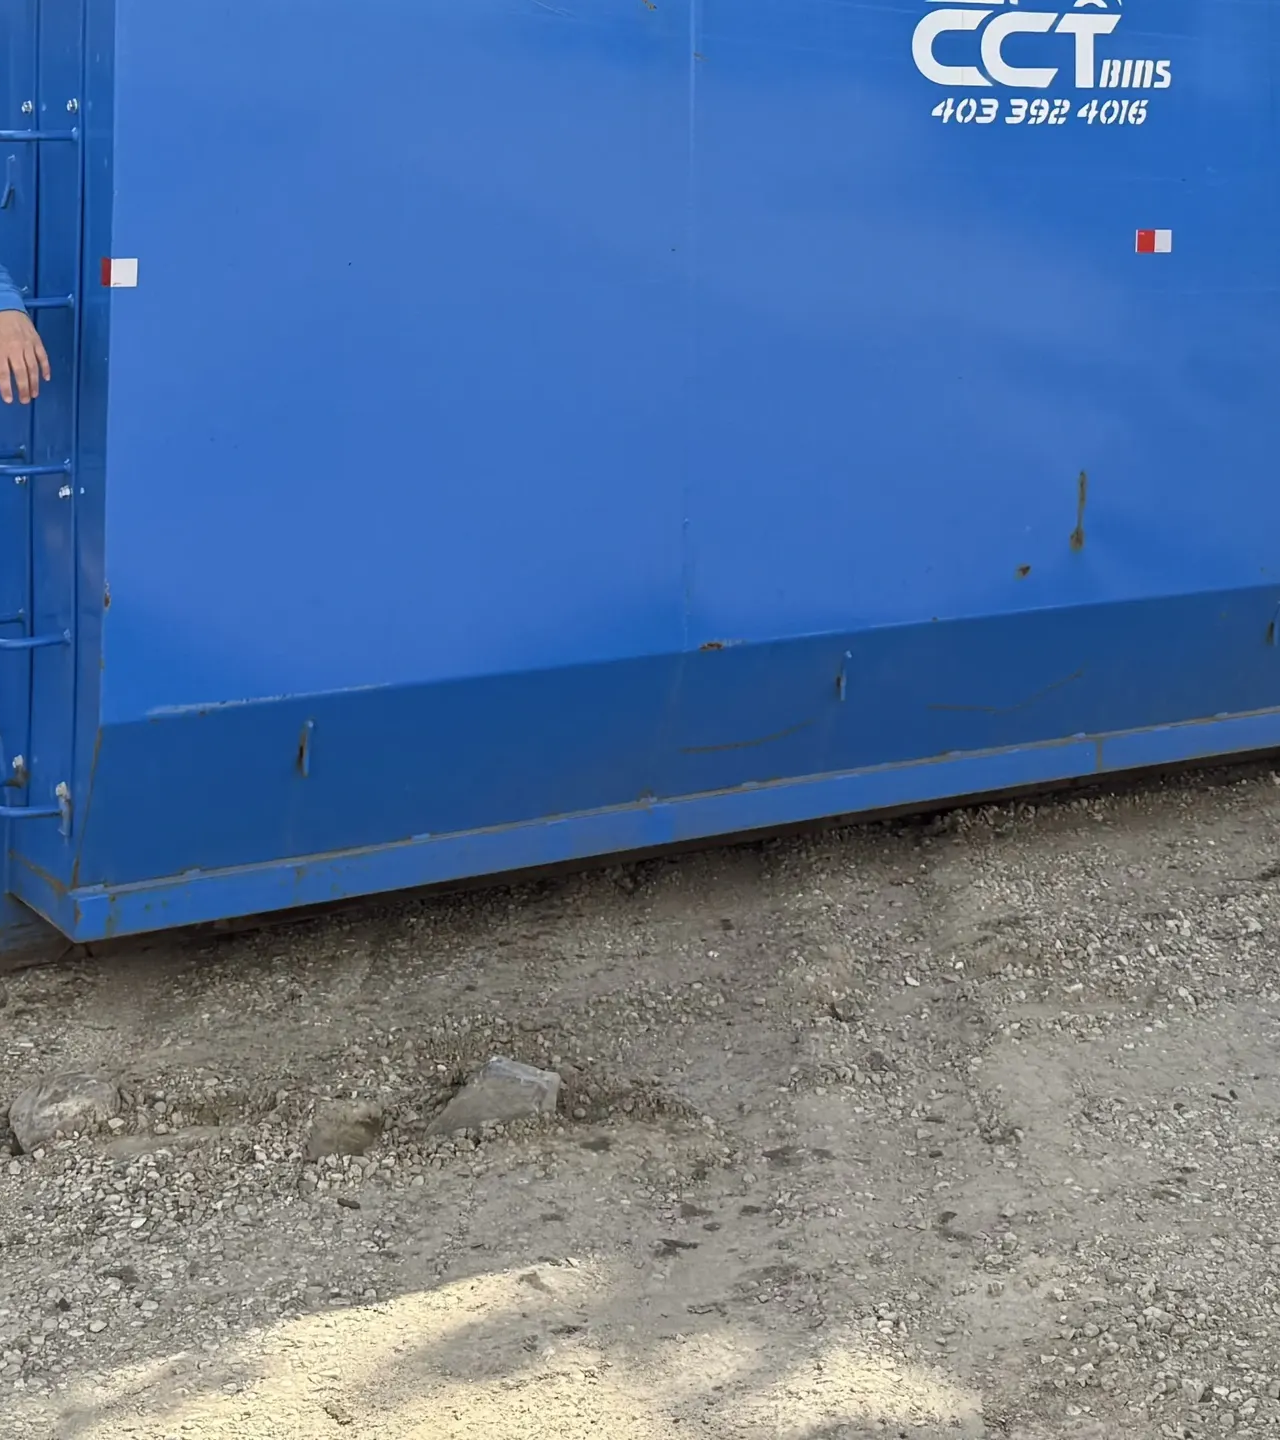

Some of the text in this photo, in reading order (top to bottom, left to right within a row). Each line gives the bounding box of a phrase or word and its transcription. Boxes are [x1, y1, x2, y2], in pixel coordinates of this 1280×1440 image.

[911, 8, 1122, 89] CCT
[931, 98, 1149, 125] 403 392 4016
